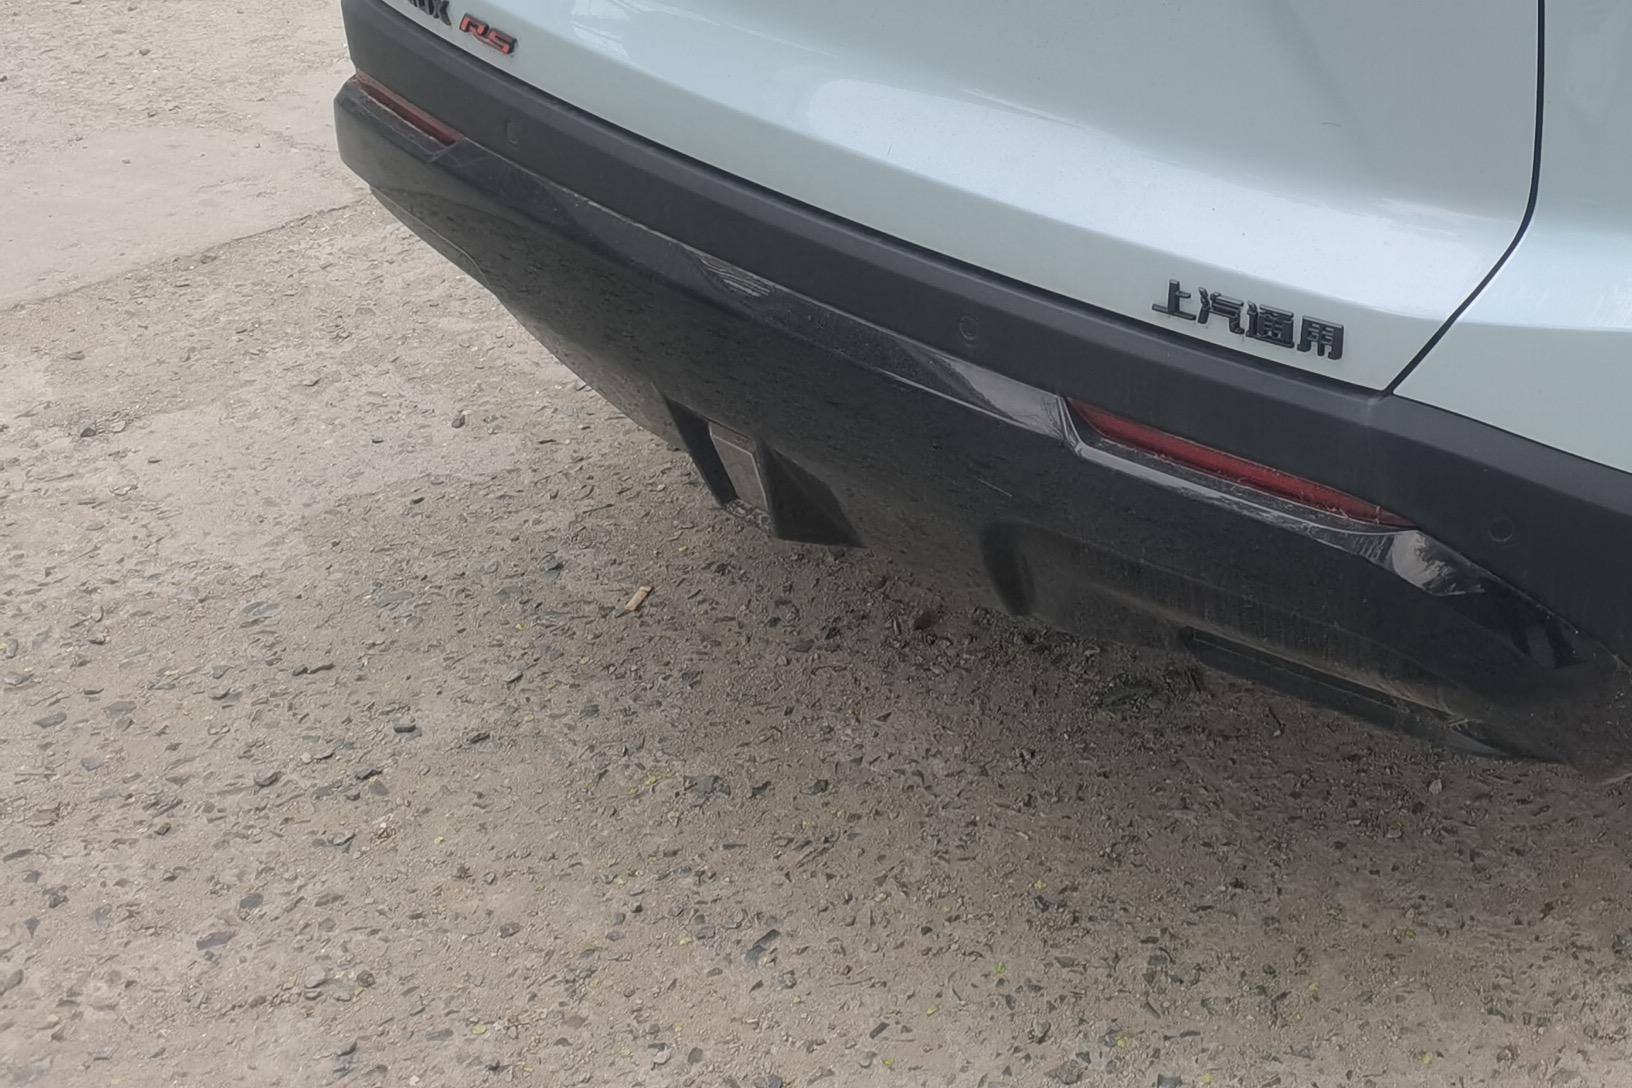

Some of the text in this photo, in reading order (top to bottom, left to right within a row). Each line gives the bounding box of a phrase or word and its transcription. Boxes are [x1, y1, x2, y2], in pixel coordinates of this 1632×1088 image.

[459, 12, 518, 55] RS
[1151, 278, 1345, 360] 上汽通用
